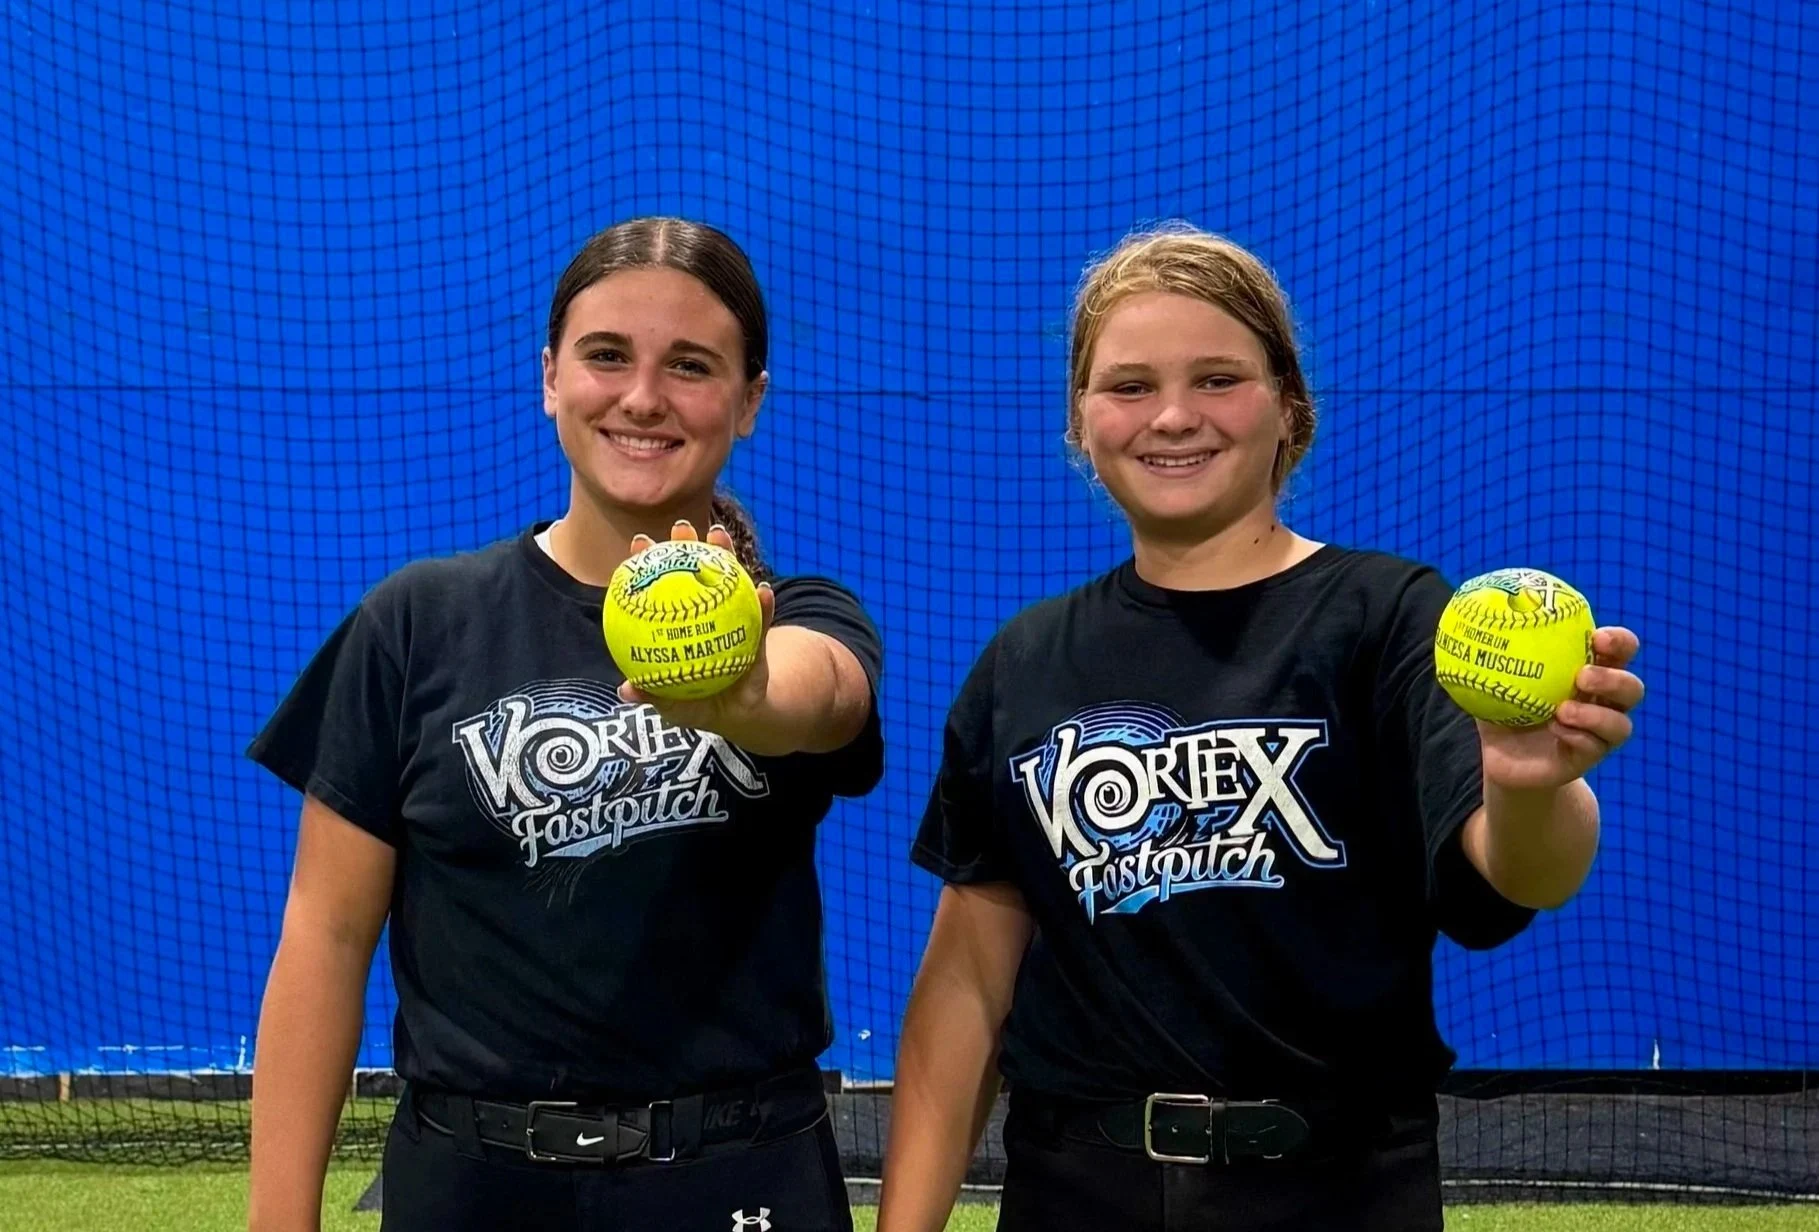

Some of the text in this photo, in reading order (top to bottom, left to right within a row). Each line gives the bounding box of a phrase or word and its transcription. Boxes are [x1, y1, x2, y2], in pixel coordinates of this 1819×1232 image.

[631, 625, 746, 663] ALYSSA MARTUCCI
[666, 625, 693, 640] HOME
[695, 620, 716, 636] RUN
[1475, 648, 1544, 679] MUSCILLO
[1014, 724, 1343, 862] VORTEX
[512, 777, 728, 867] Fastpitch
[1069, 832, 1285, 925] Fastpitch
[704, 1100, 743, 1129] IKE
